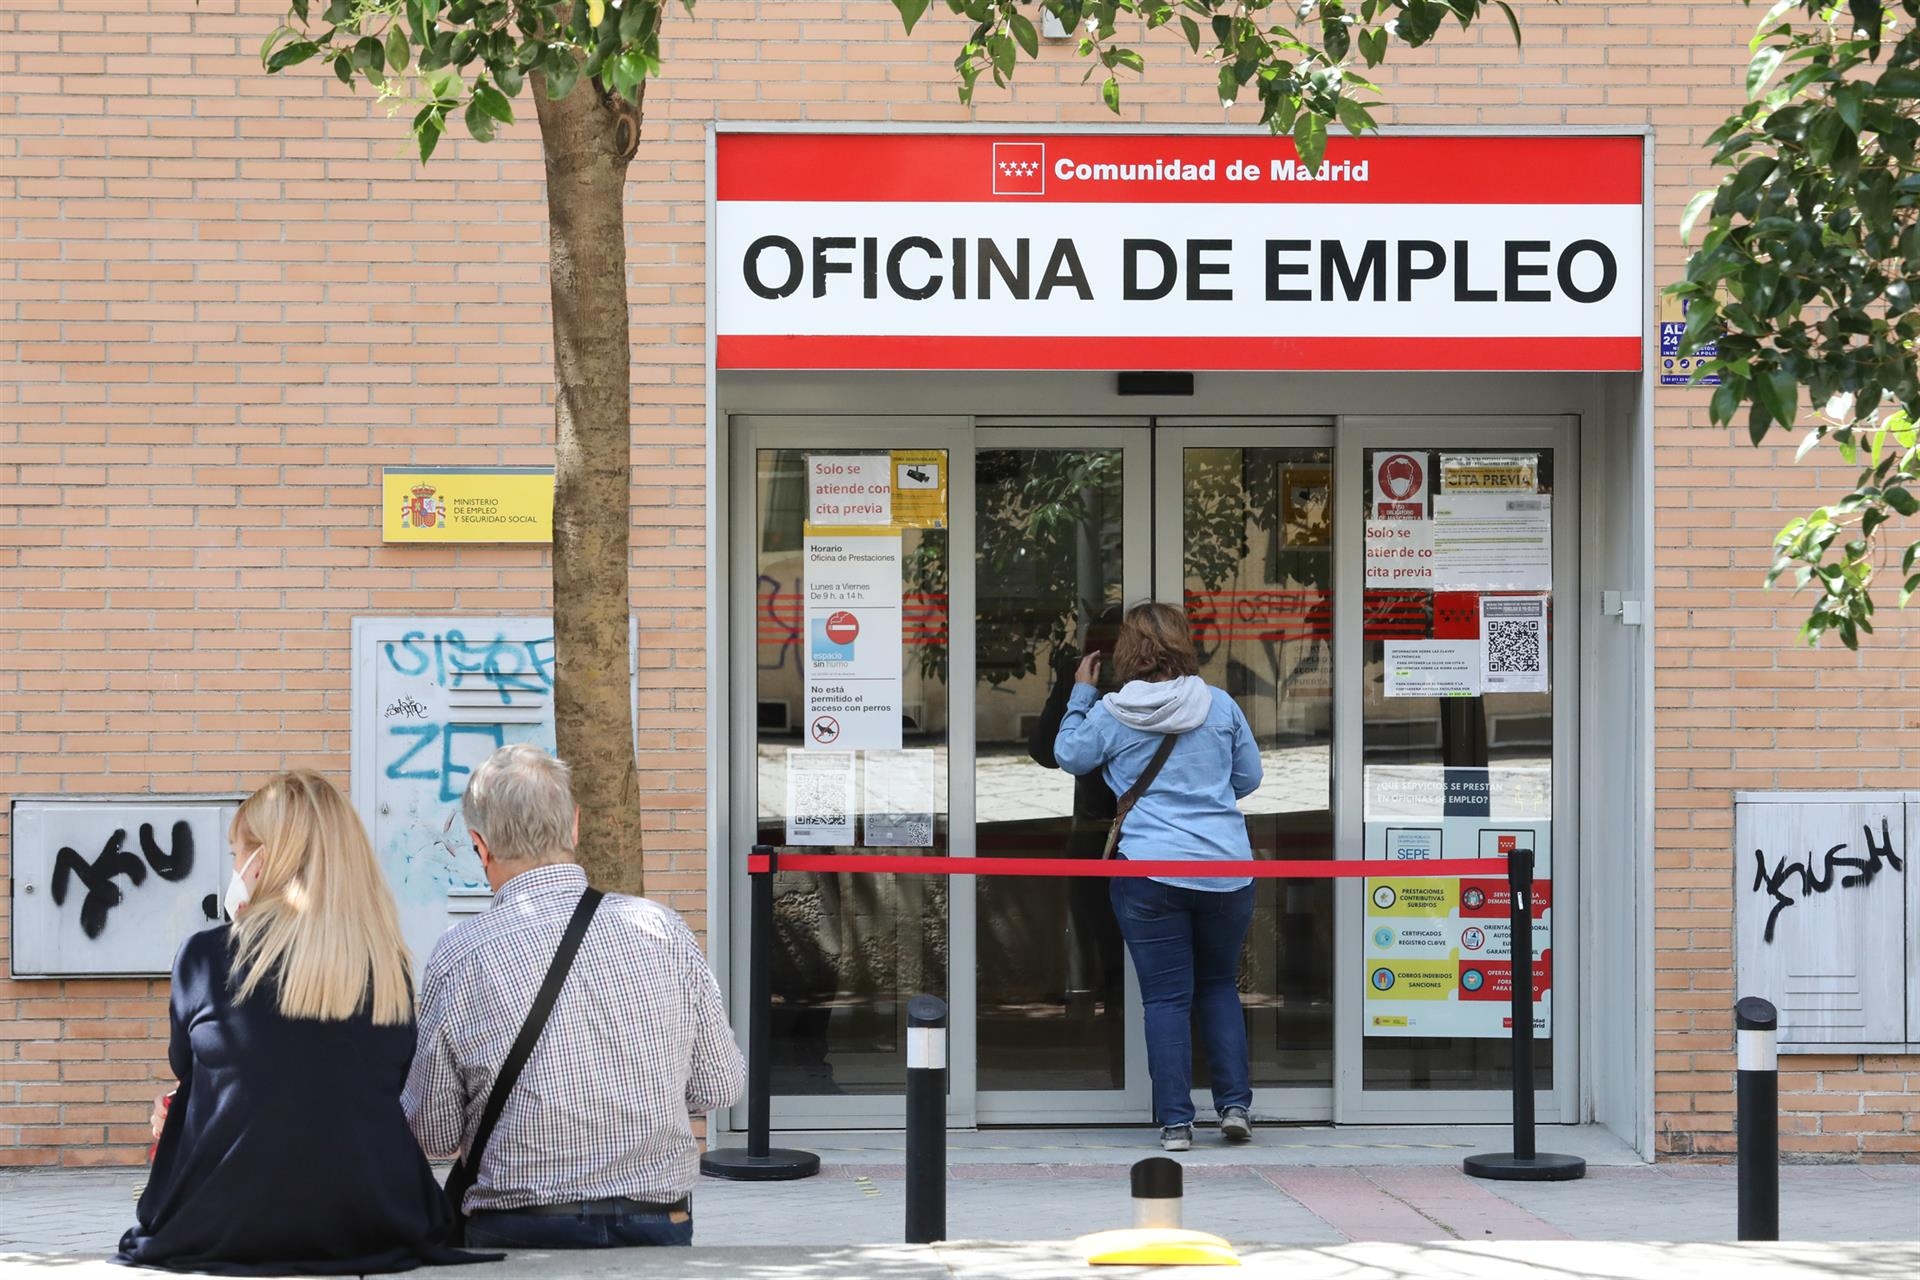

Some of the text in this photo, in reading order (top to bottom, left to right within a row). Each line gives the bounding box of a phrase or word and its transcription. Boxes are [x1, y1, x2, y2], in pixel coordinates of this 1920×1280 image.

[1054, 158, 1369, 182] Comunidad de Madrid
[743, 235, 1618, 303] OFICINA DE EMPLEO
[1663, 336, 1678, 345] 24
[815, 463, 861, 475] Solo se
[1448, 474, 1531, 486] CITA PREVIA
[816, 483, 890, 494] atiende con
[453, 498, 499, 506] MINISTERIO
[466, 507, 497, 515] EMPLEO
[816, 503, 840, 514] cita
[843, 503, 883, 516] previa
[453, 515, 537, 523] Y SEGURIDAD SOCIAL
[1366, 527, 1411, 538] Solo se
[810, 544, 843, 553] Horario
[1367, 547, 1415, 558] atiende
[810, 553, 895, 562] Oficina de Prestaciones
[1367, 567, 1432, 580] cita previa
[810, 583, 834, 591] Lunes
[841, 583, 871, 591] Viernes
[810, 592, 821, 600] De
[822, 592, 829, 600] 9
[830, 592, 837, 600] h.
[846, 592, 856, 600] 14
[857, 592, 865, 600] h.
[813, 652, 843, 662] espacio
[813, 659, 849, 669] sin humo
[811, 685, 845, 694] No está
[811, 695, 863, 704] permitido el
[863, 705, 892, 713] perros
[1401, 782, 1448, 791] SERVICIOS
[1450, 782, 1462, 791] SE
[1463, 782, 1503, 791] PRESTAN
[1435, 796, 1446, 804] DE
[1448, 795, 1489, 804] EMPLEO?
[1397, 848, 1430, 860] SEPE
